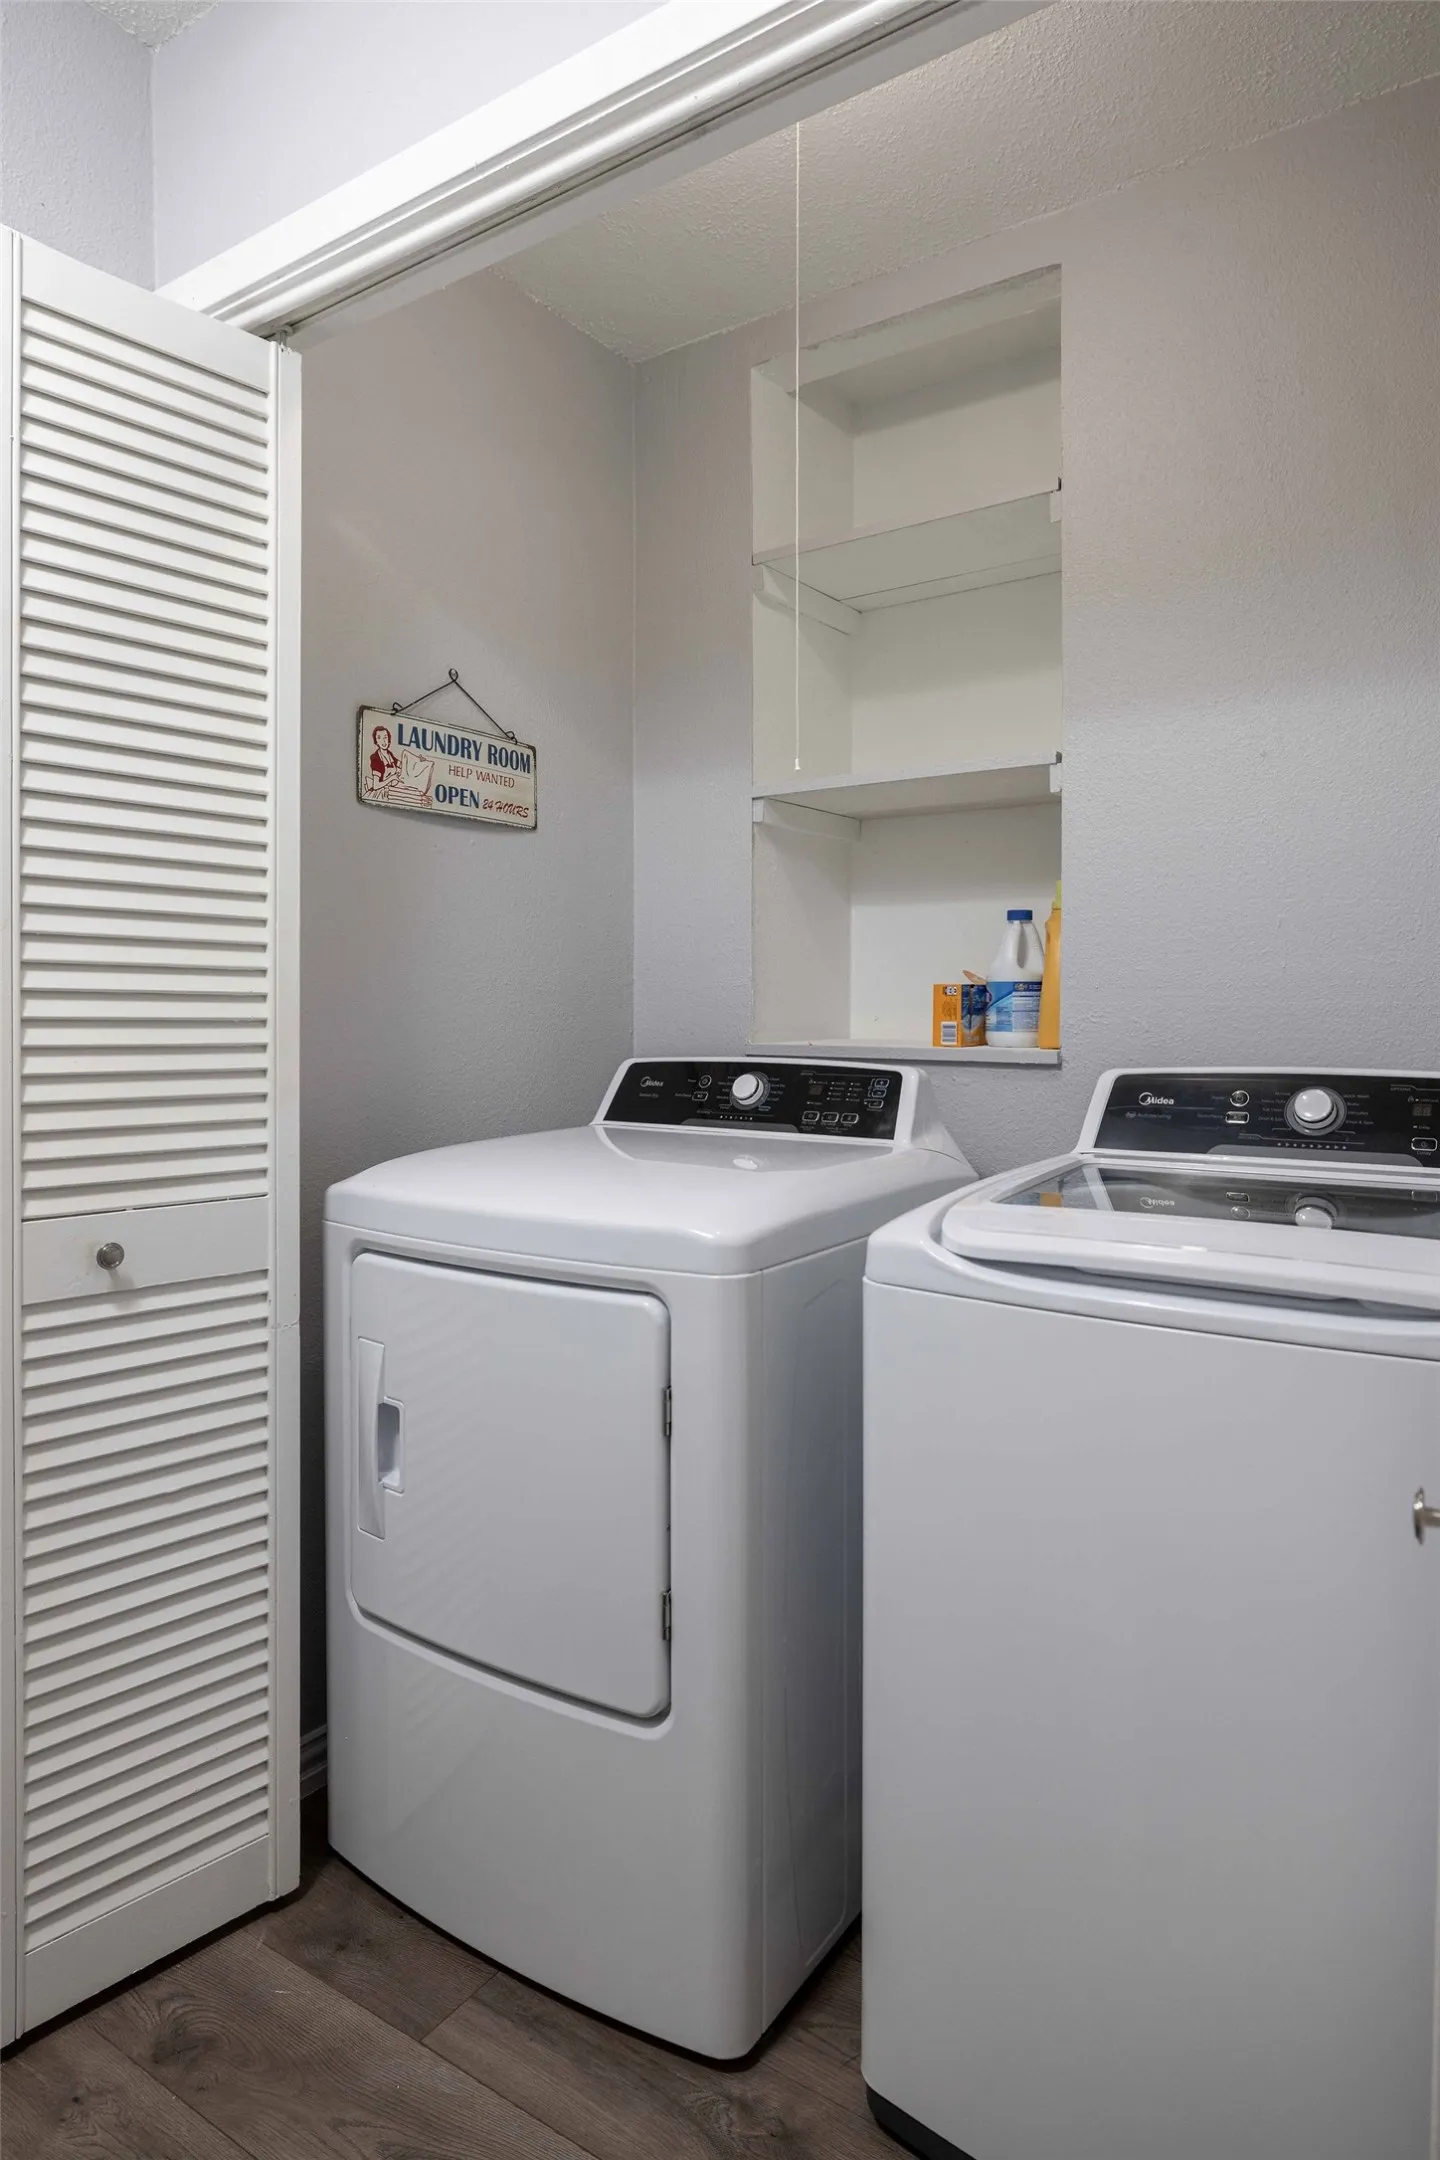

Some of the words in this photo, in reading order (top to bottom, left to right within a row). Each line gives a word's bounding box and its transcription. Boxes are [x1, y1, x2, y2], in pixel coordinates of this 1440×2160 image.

[397, 723, 483, 762] LAUNDRY
[487, 743, 531, 774] ROOM
[448, 765, 473, 780] HELP
[475, 769, 515, 789] WANTED
[434, 784, 480, 809] OPEN
[482, 798, 493, 810] 24
[493, 800, 530, 818] HOURS
[640, 1076, 664, 1088] Midea
[1138, 1091, 1175, 1106] Midea
